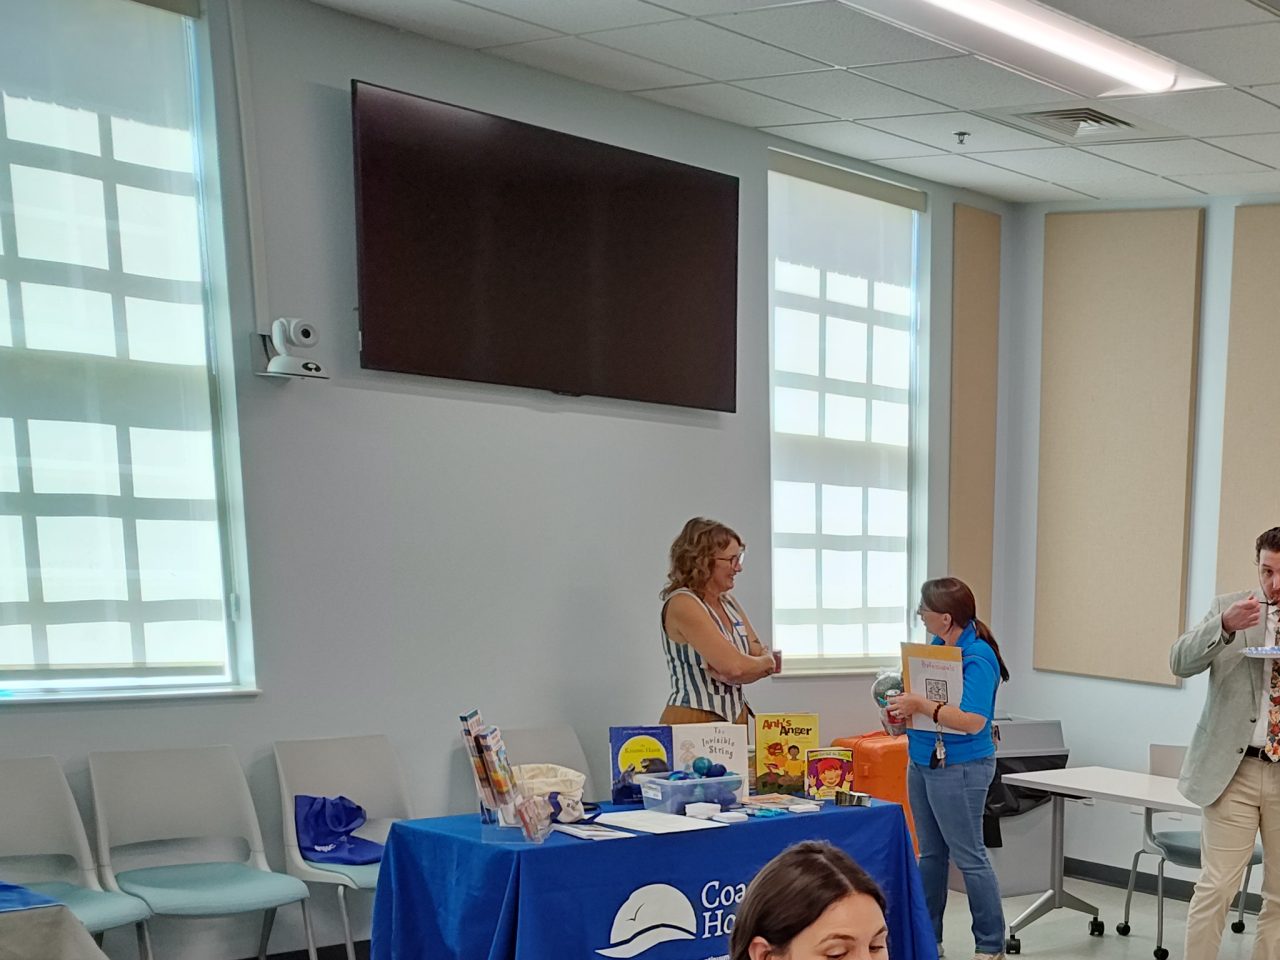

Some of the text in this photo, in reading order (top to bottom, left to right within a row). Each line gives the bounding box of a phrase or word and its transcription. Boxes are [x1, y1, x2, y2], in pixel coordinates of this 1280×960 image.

[762, 718, 792, 730] Anh's
[779, 726, 812, 736] Anger
[702, 736, 735, 747] Invisible
[709, 745, 733, 760] String
[702, 881, 747, 908] Coa
